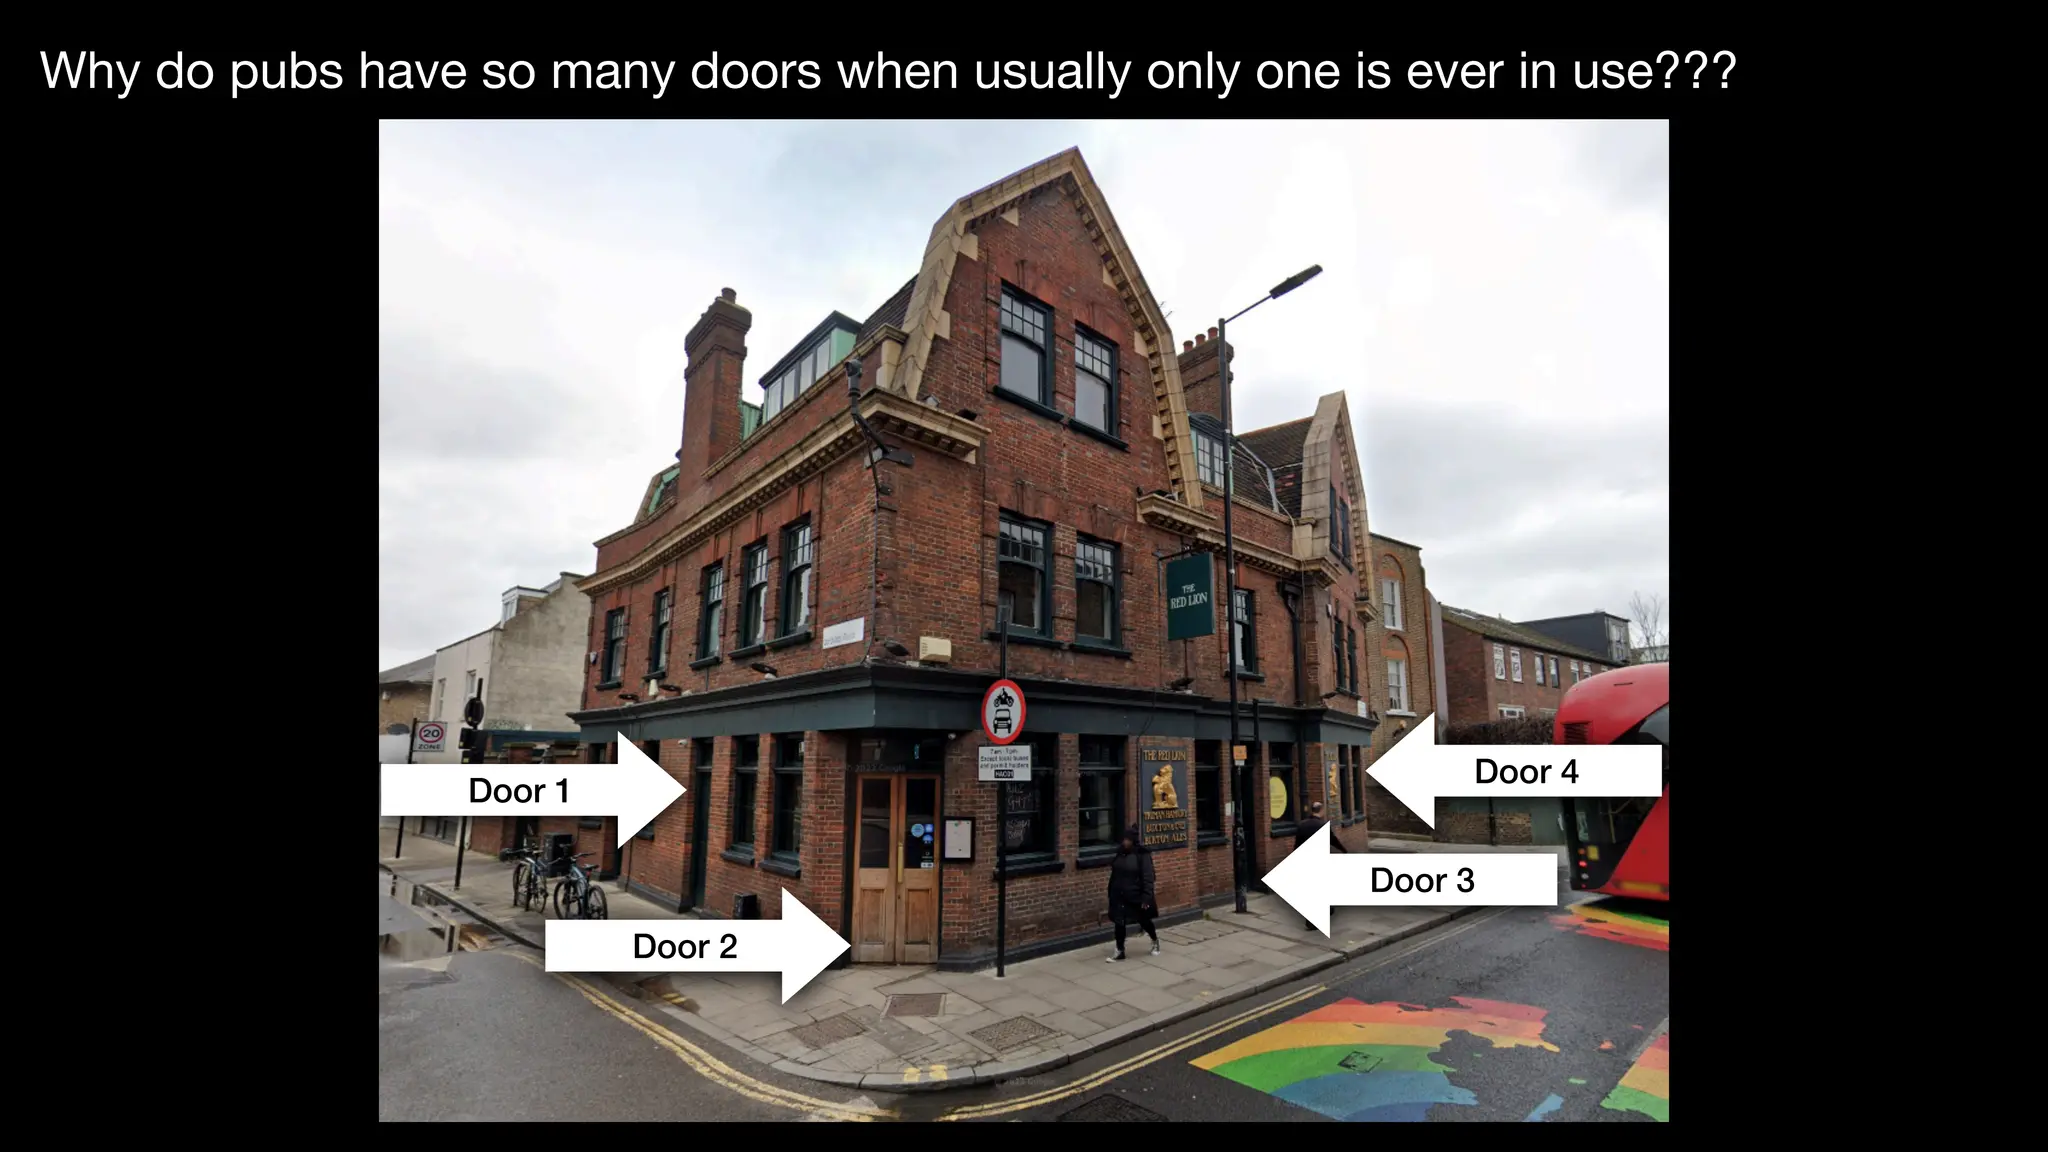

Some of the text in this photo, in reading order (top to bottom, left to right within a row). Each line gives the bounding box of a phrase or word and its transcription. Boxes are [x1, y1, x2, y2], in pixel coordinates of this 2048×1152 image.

[1182, 583, 1195, 594] THE
[1170, 592, 1208, 609] RED LION
[423, 729, 440, 738] 20
[1143, 749, 1157, 761] THE
